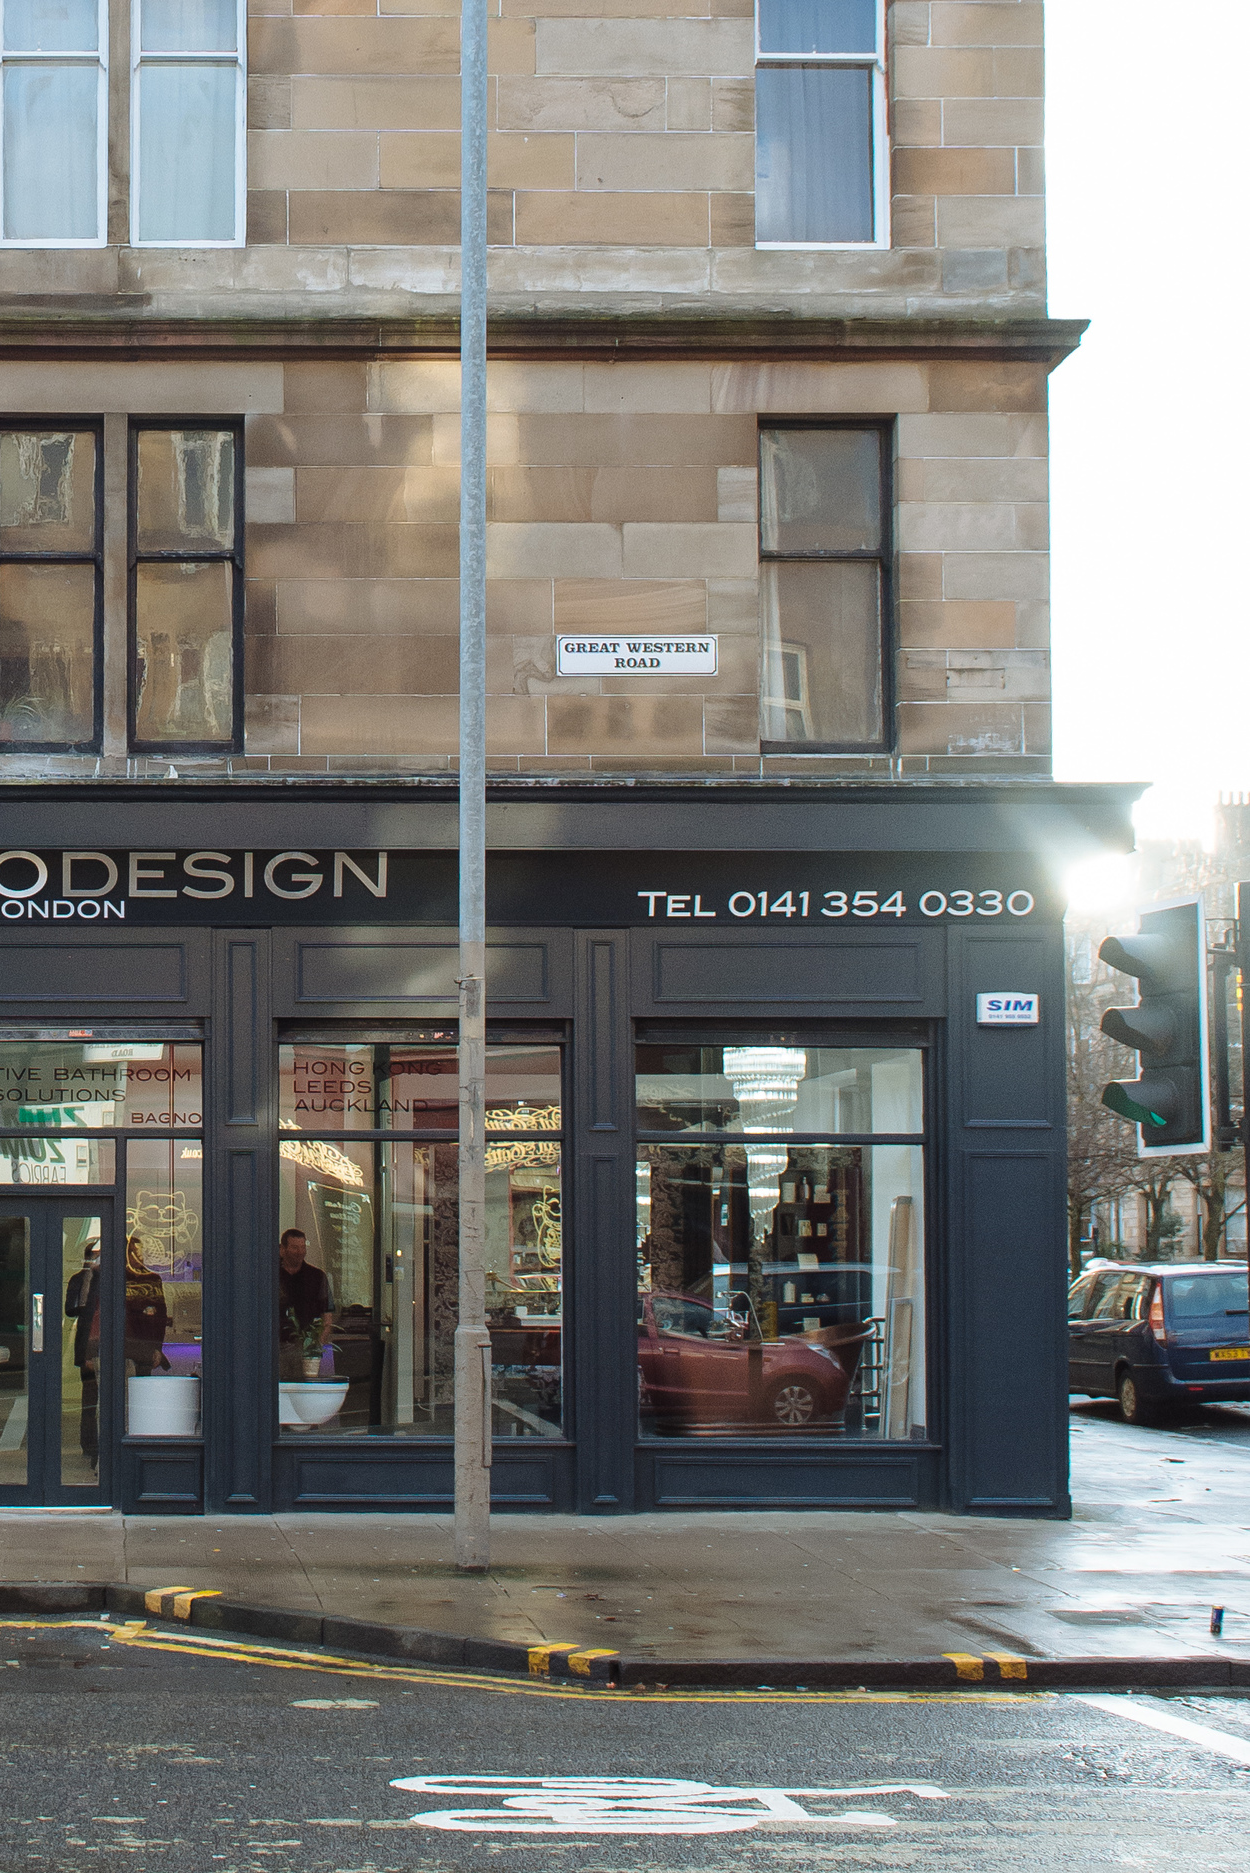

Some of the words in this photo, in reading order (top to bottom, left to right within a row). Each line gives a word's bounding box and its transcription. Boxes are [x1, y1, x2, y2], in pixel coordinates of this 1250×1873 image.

[564, 641, 620, 654] GREAT
[625, 641, 711, 654] WESTERN
[614, 657, 661, 669] ROAD
[727, 890, 811, 918] 0141
[820, 890, 907, 918] 354
[918, 890, 1036, 918] 0330
[986, 999, 1034, 1011] SIM
[53, 1067, 191, 1082] BATHROOM
[293, 1061, 365, 1075] HONG
[373, 1062, 442, 1076] KONG
[293, 1080, 372, 1094] LEEDS
[293, 1099, 429, 1113] AUCKLAND
[131, 1112, 203, 1125] BAGNO
